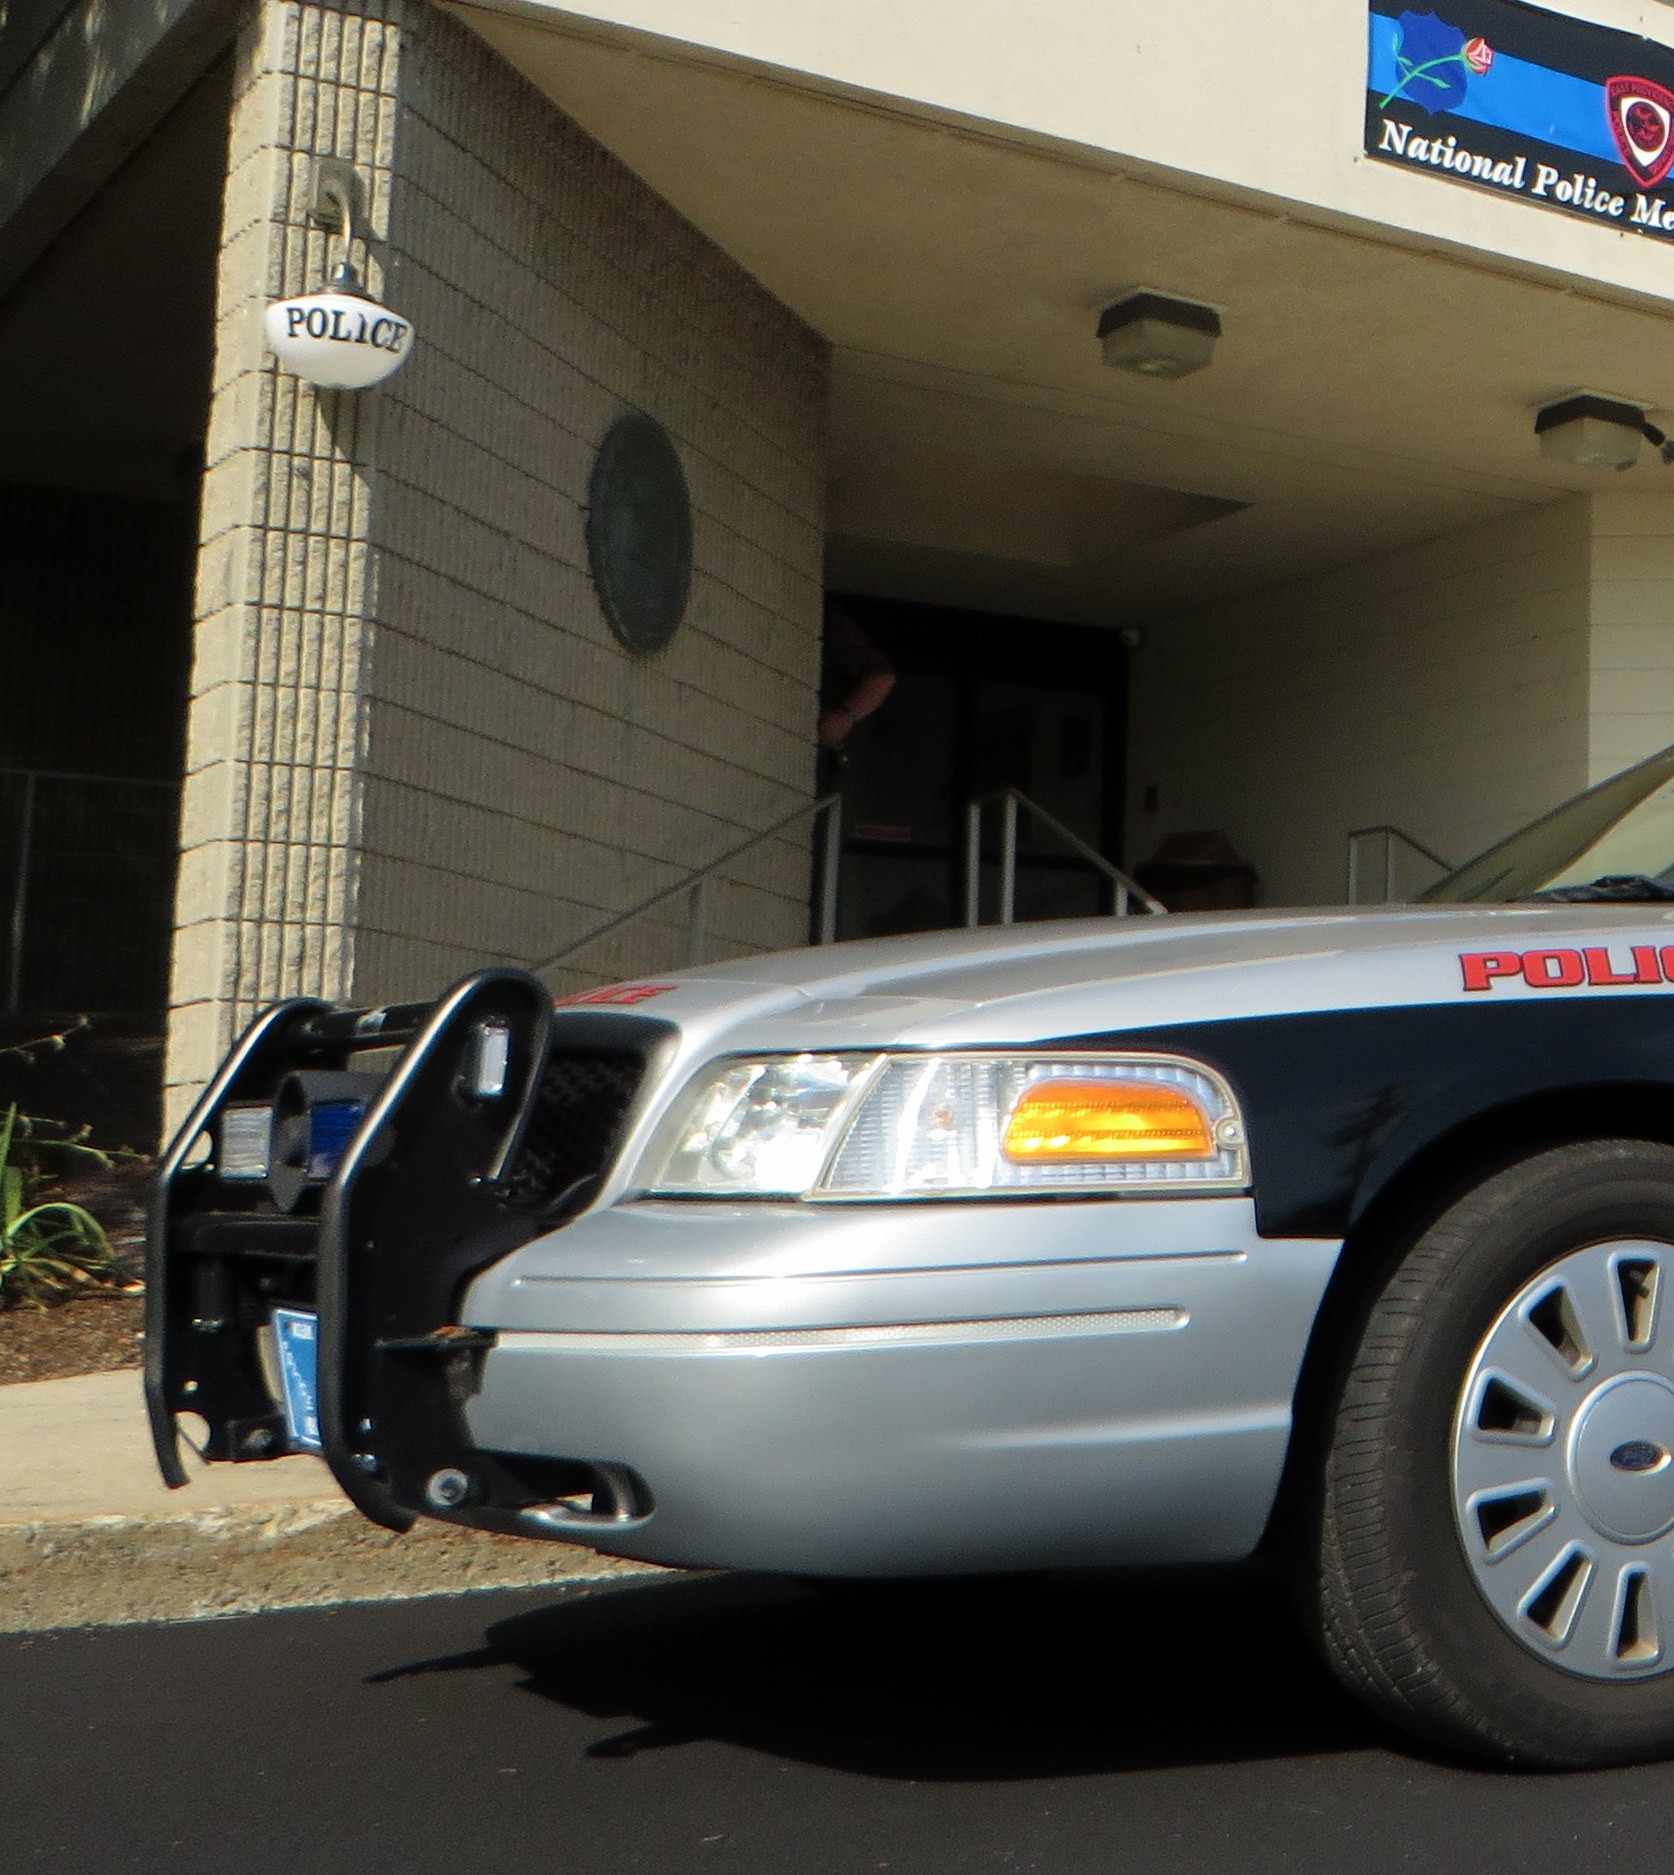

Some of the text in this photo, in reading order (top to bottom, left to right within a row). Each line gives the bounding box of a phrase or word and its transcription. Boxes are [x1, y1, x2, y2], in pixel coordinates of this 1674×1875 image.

[1380, 118, 1527, 190] National
[1535, 163, 1624, 217] Police
[286, 306, 407, 353] POLICE
